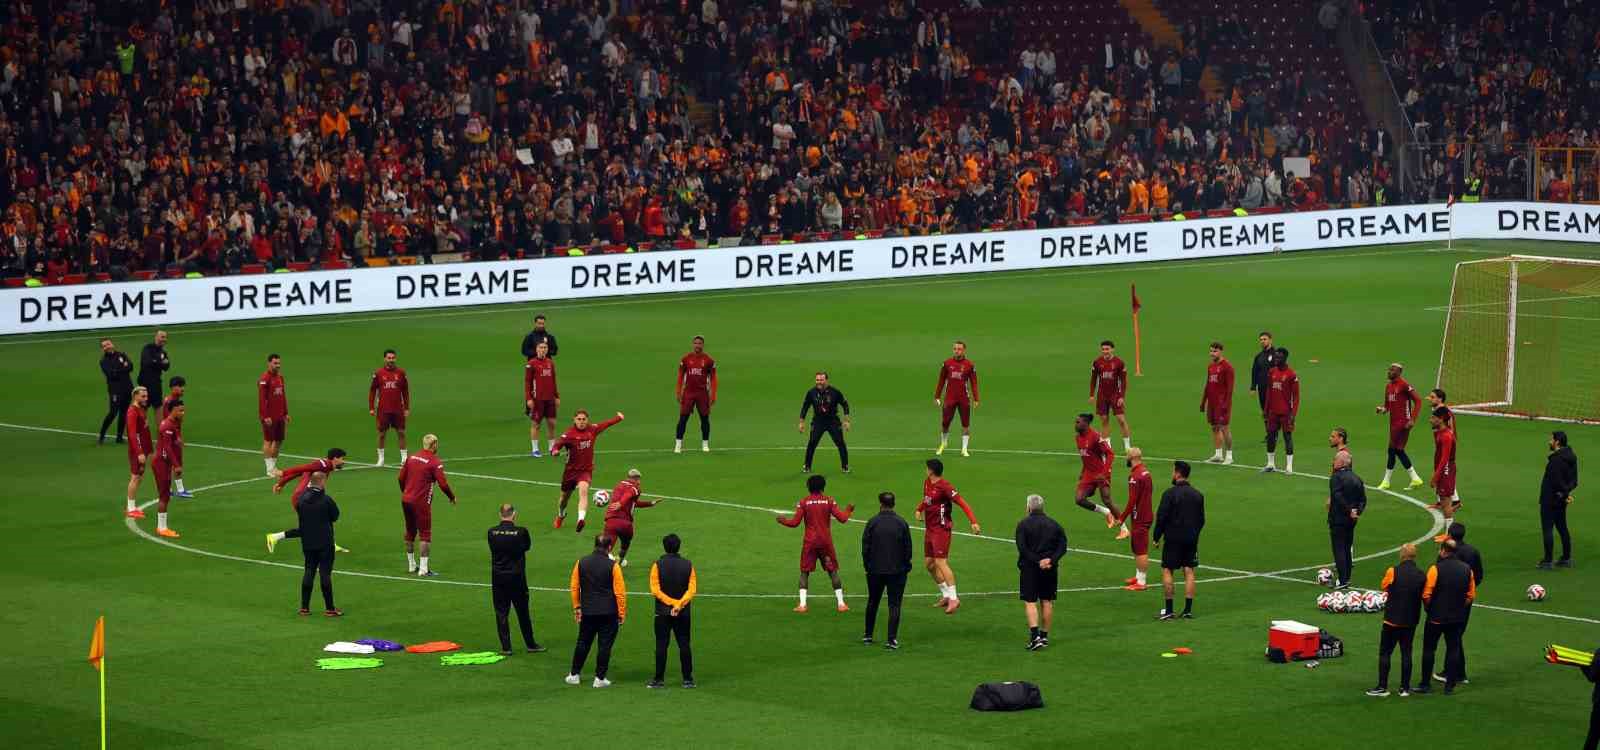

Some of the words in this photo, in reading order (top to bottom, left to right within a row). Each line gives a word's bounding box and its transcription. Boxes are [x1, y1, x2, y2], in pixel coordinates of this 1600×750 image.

[20, 289, 167, 322] DREAME
[214, 278, 353, 311] DREAME
[396, 268, 529, 300] DREAME
[571, 259, 696, 290] DREAME
[735, 249, 854, 279] DREAME
[891, 240, 1005, 269] DREAME
[1040, 231, 1148, 260] DREAME
[1182, 221, 1286, 250] DREAME
[1317, 211, 1451, 240] DREAME
